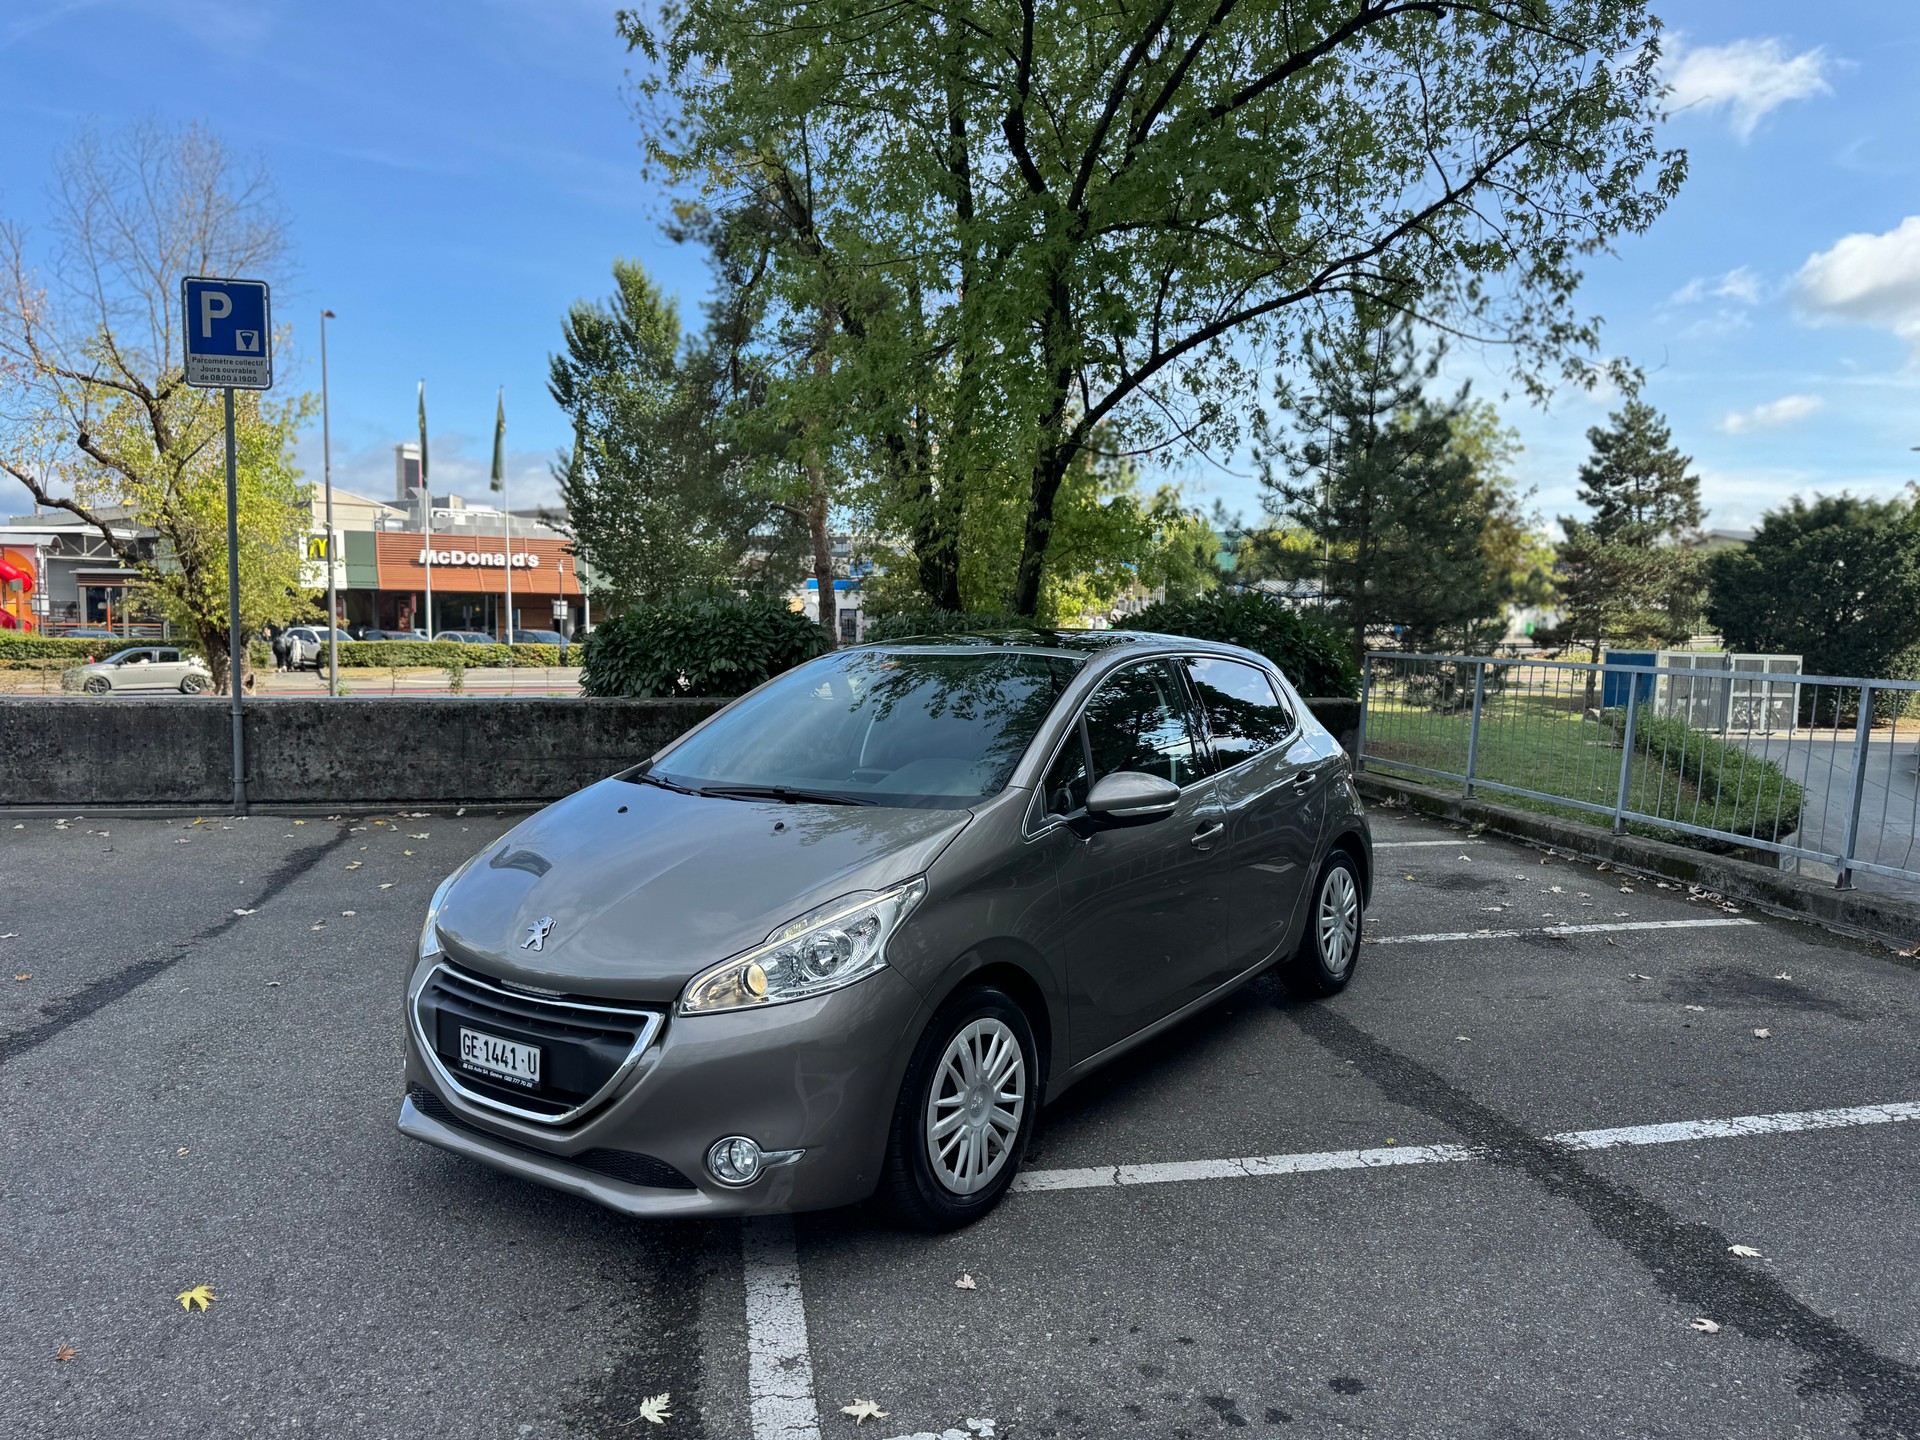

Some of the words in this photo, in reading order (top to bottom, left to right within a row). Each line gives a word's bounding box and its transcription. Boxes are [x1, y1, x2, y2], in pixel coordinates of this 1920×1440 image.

[201, 290, 233, 338] P
[222, 367, 257, 375] ouvrables
[418, 549, 540, 568] McDonald's
